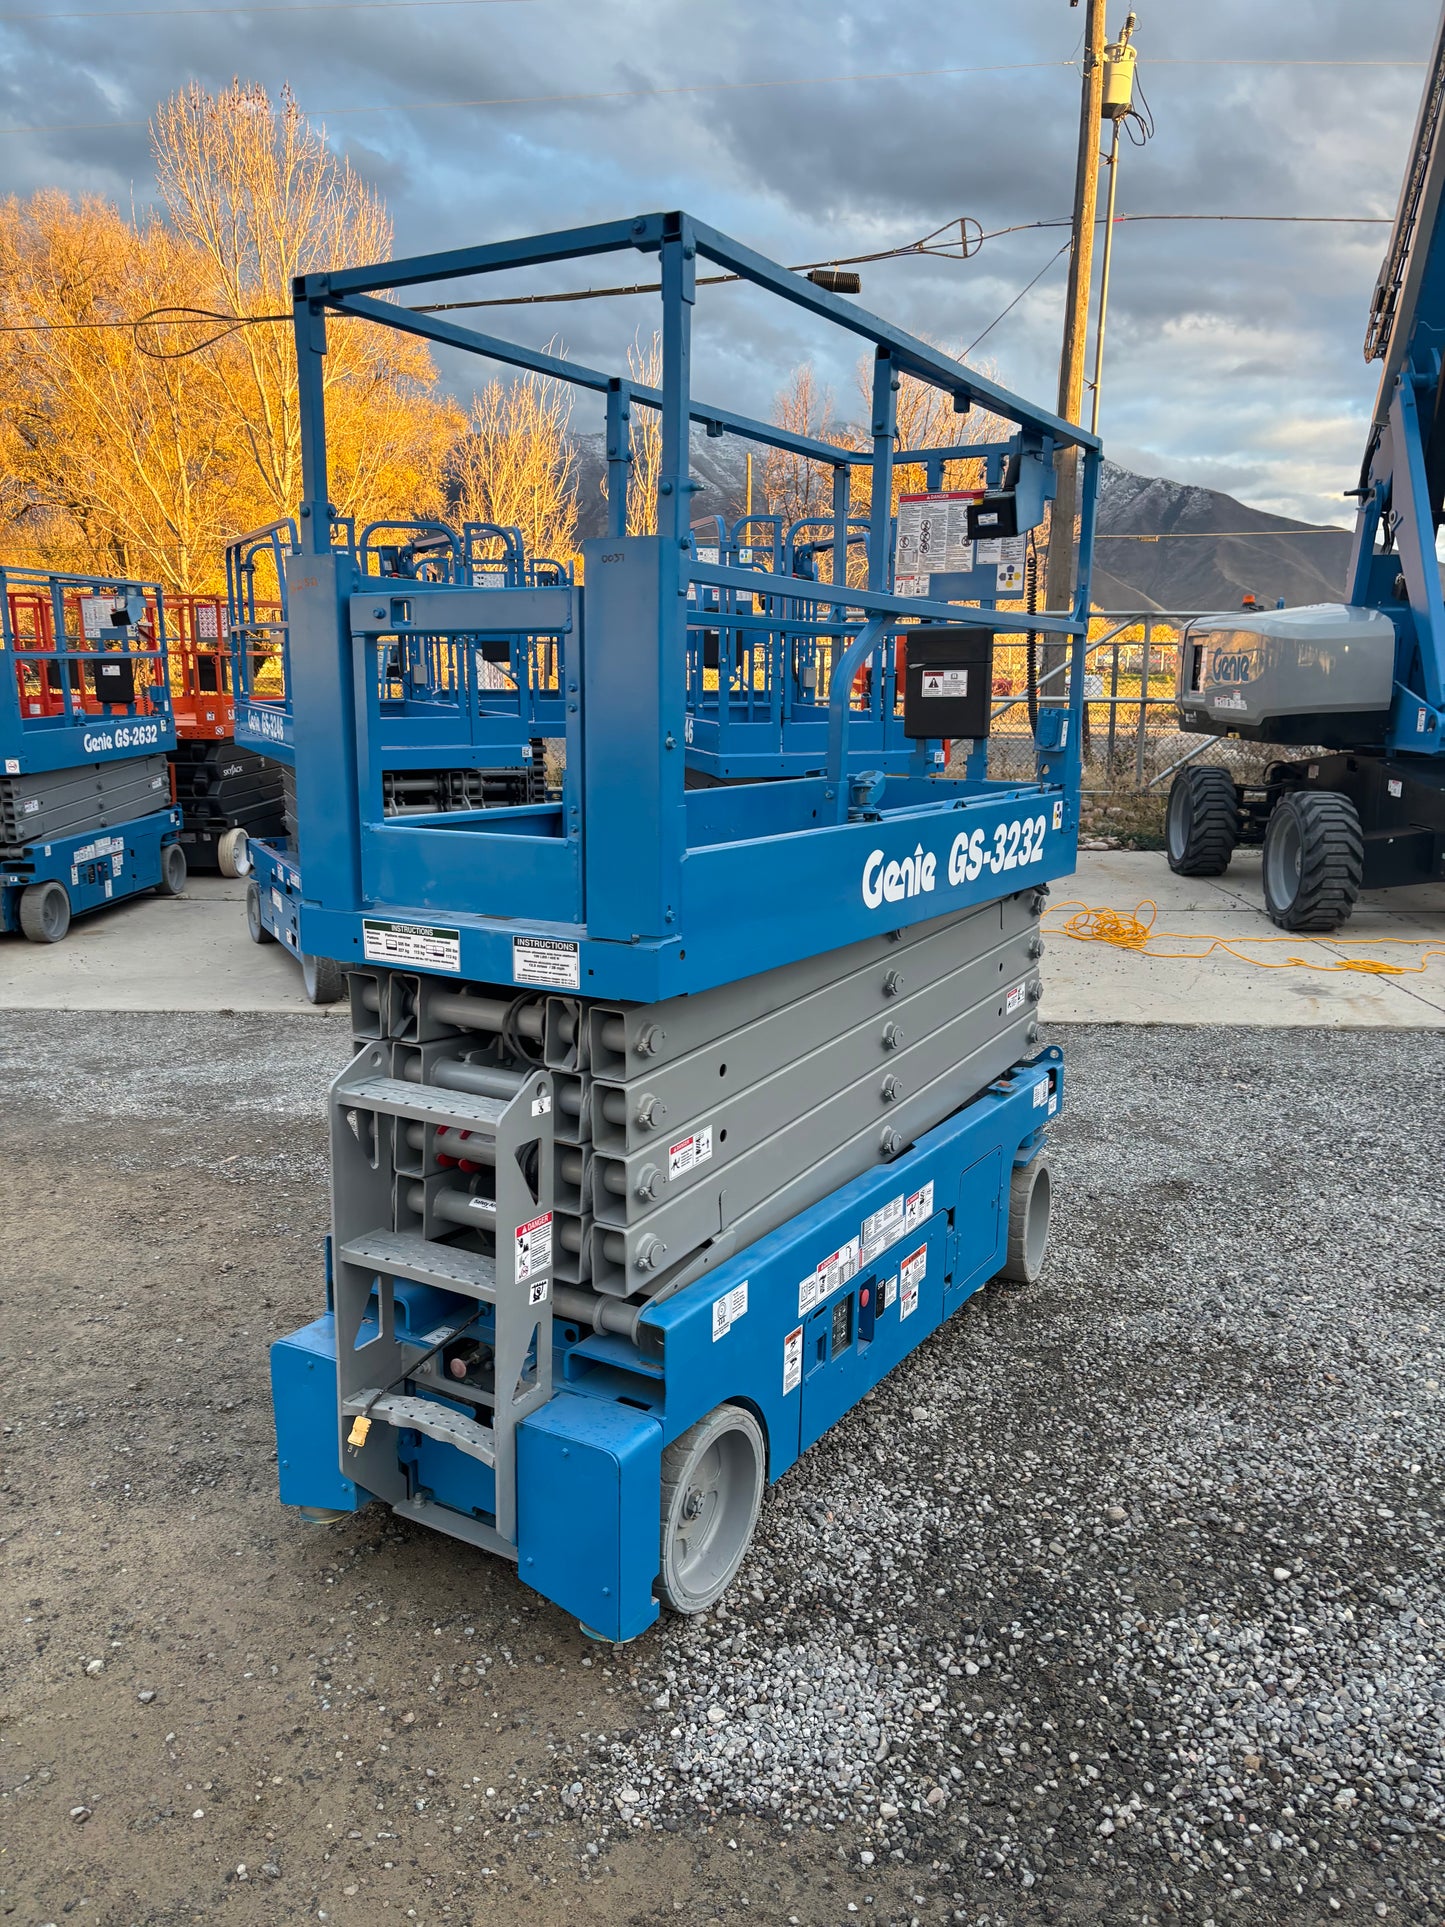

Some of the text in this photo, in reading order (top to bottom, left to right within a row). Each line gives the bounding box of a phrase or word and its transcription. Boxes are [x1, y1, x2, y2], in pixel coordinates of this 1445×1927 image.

[1213, 646, 1250, 682] Genie
[84, 725, 158, 753] Genie GS-2632
[862, 815, 1046, 909] Genie GS-3232
[391, 924, 434, 936] INSTRUCTIONS
[517, 938, 574, 951] INSTRUCTIONS
[528, 1214, 548, 1231] DANGER
